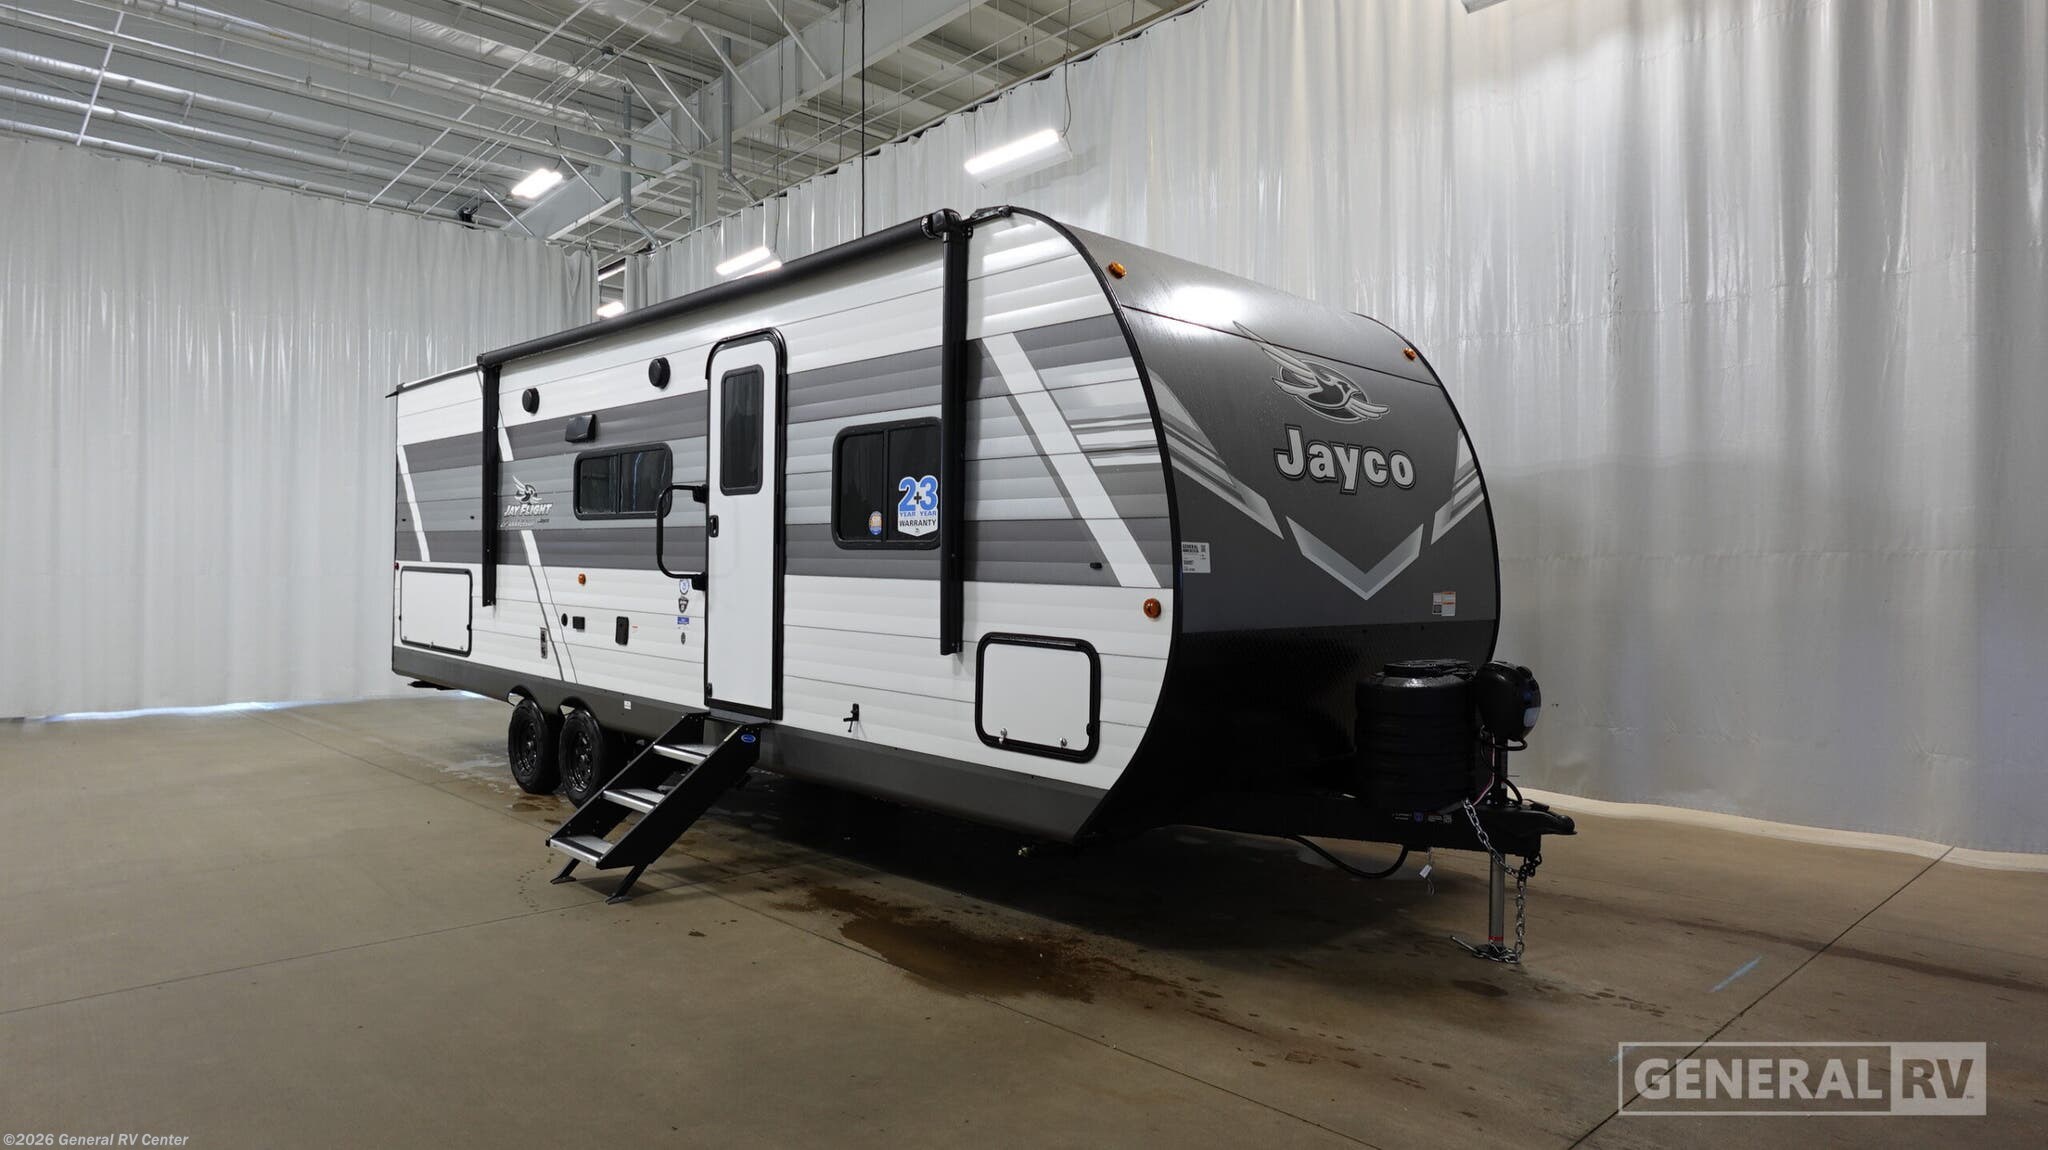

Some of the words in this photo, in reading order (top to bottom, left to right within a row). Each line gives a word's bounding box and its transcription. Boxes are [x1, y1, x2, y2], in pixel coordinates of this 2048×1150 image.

[1275, 425, 1415, 494] Jayco
[504, 505, 520, 516] JAY
[520, 503, 552, 516] FLIGHT
